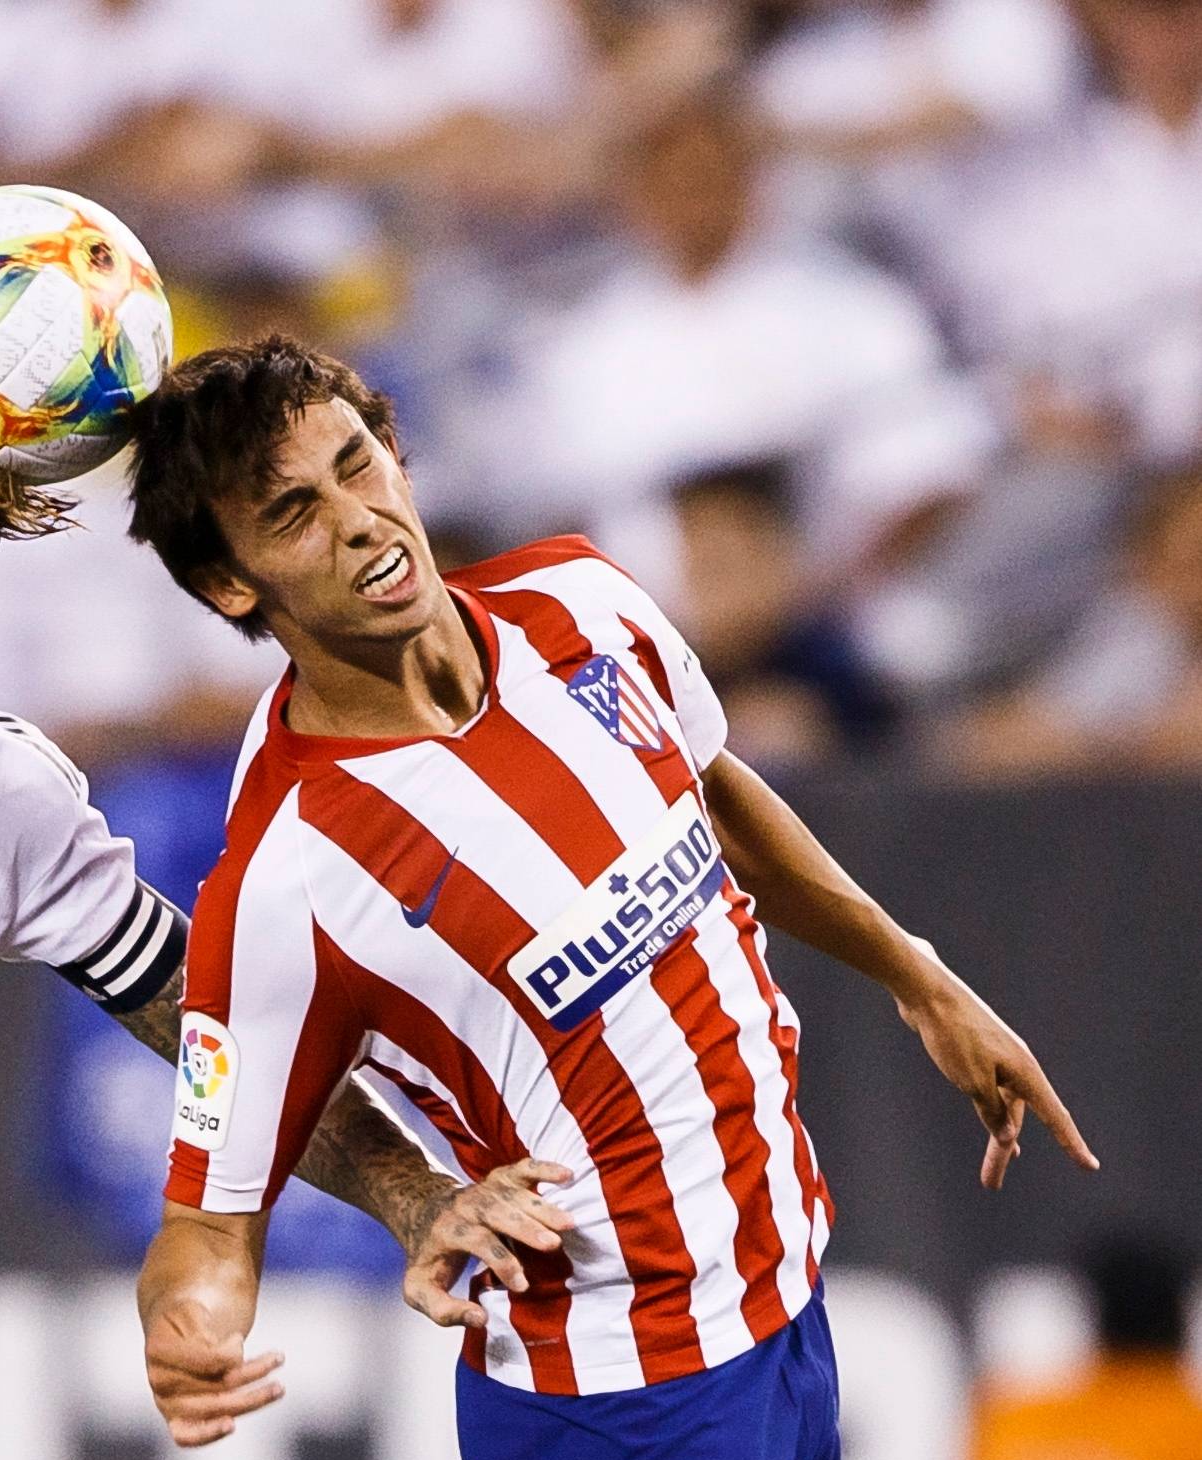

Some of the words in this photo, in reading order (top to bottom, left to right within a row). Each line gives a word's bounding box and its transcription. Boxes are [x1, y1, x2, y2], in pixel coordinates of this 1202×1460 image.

[526, 818, 712, 1010] Plus500
[619, 933, 665, 976] Trade
[662, 894, 707, 938] Online
